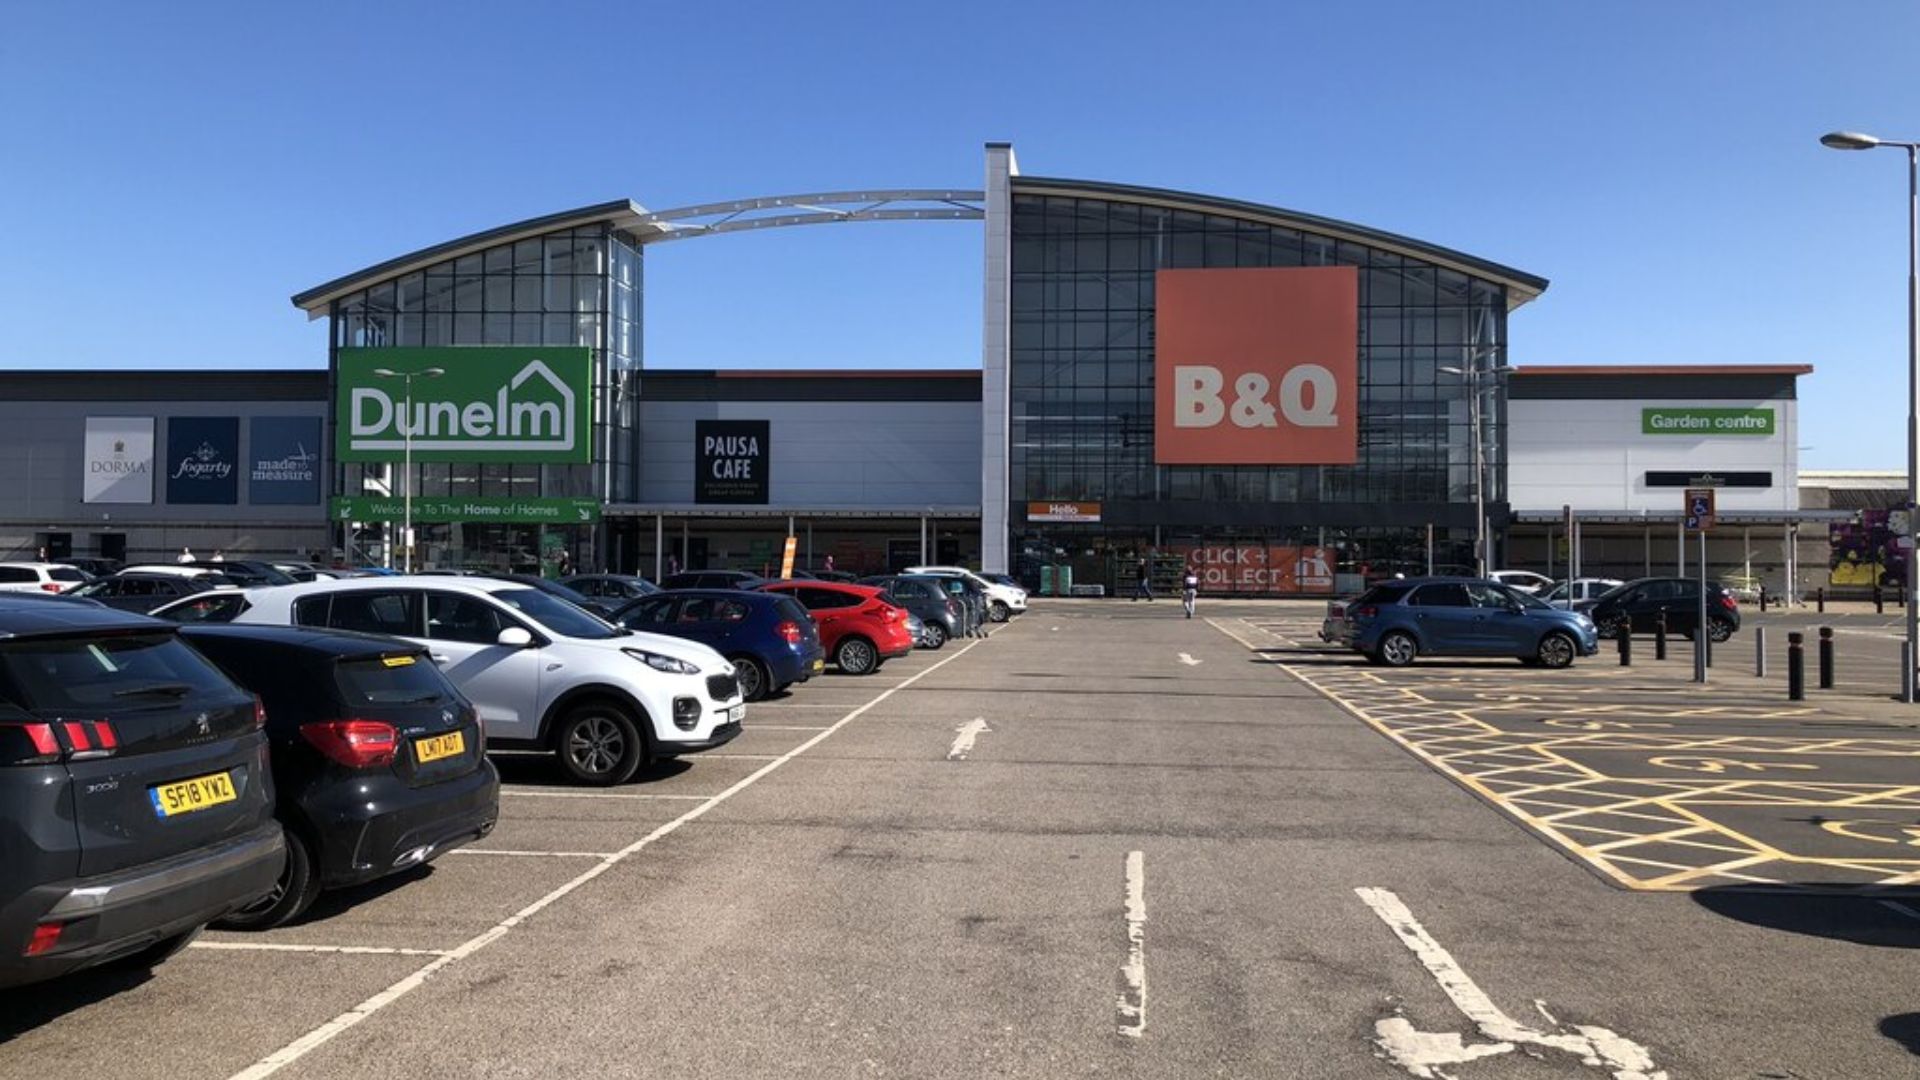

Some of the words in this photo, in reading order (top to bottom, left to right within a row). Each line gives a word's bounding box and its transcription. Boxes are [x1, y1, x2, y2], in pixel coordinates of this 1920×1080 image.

[1174, 364, 1338, 428] B&Q
[351, 385, 562, 437] Dunelm
[1651, 414, 1710, 429] Garden
[1715, 415, 1767, 429] centre
[704, 436, 759, 456] PAUSA
[91, 461, 147, 473] DORMA
[172, 457, 231, 479] fogarty
[258, 458, 296, 470] made
[712, 459, 751, 479] CAFE
[252, 470, 312, 481] measure
[370, 504, 420, 515] Welcoe
[424, 504, 438, 515] To
[440, 504, 460, 515] The
[464, 504, 501, 515] Home
[502, 503, 515, 515] of
[517, 504, 559, 516] Homes
[1049, 503, 1079, 514] Hello
[1192, 548, 1250, 563] CLICK
[1256, 550, 1267, 563] +
[165, 783, 201, 809] SF18
[200, 777, 229, 799] YWZ
